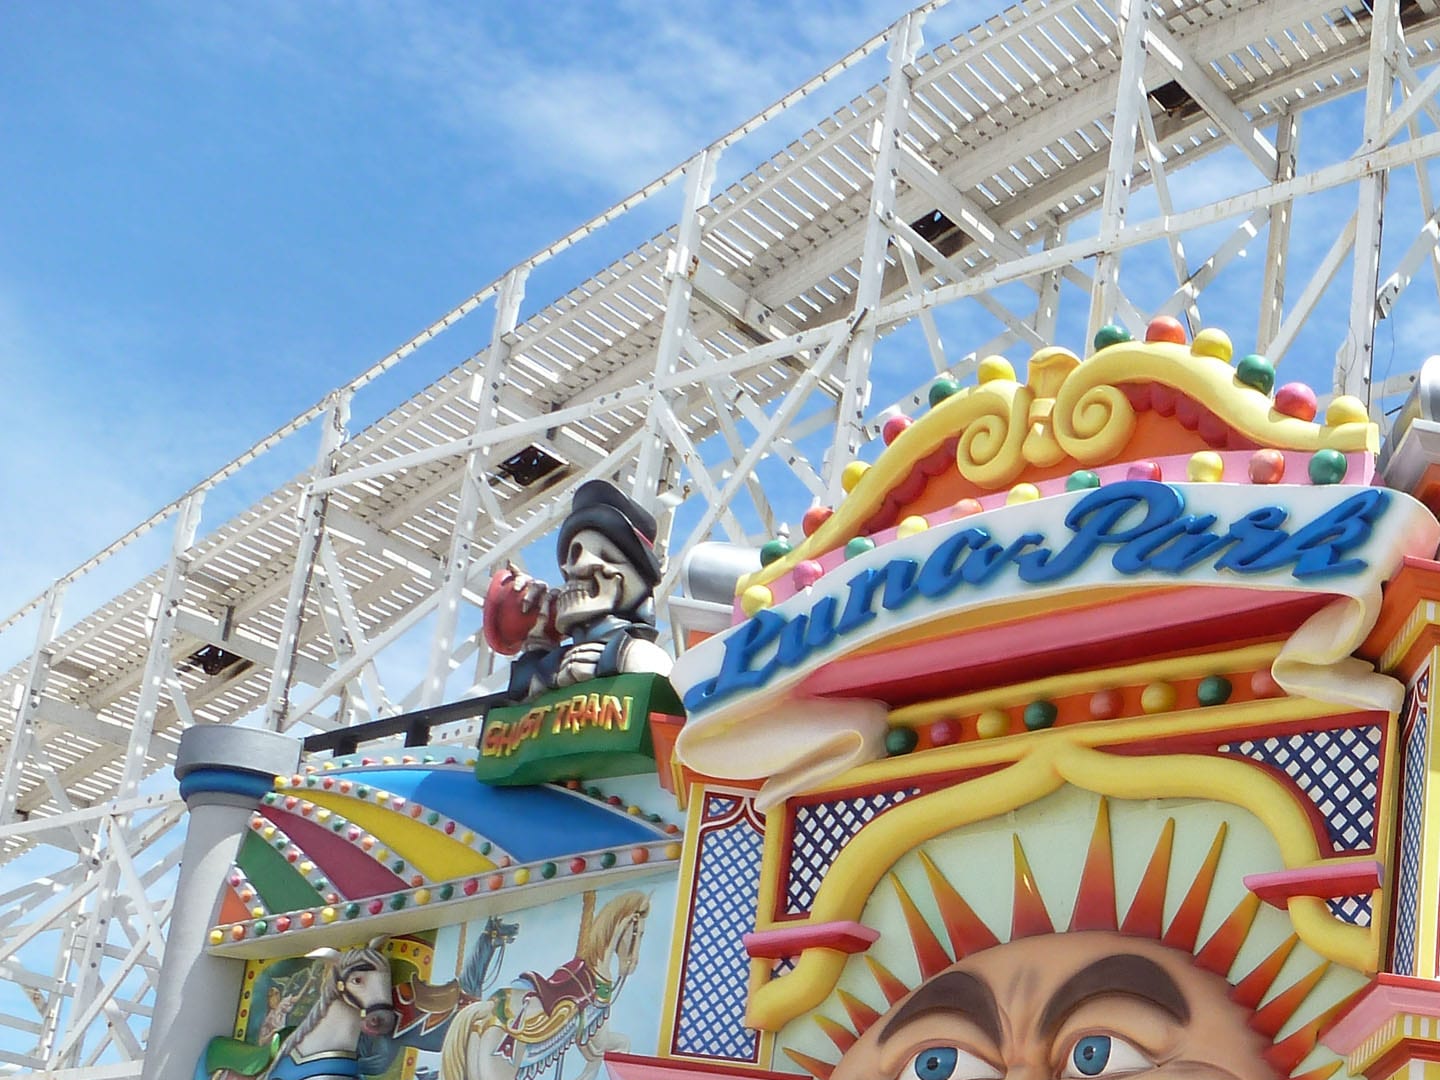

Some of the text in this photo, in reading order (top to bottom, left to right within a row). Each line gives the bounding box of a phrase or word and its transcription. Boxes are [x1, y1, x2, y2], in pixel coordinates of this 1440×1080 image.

[683, 480, 1390, 713] Luna Park
[552, 693, 633, 734] TRAIN
